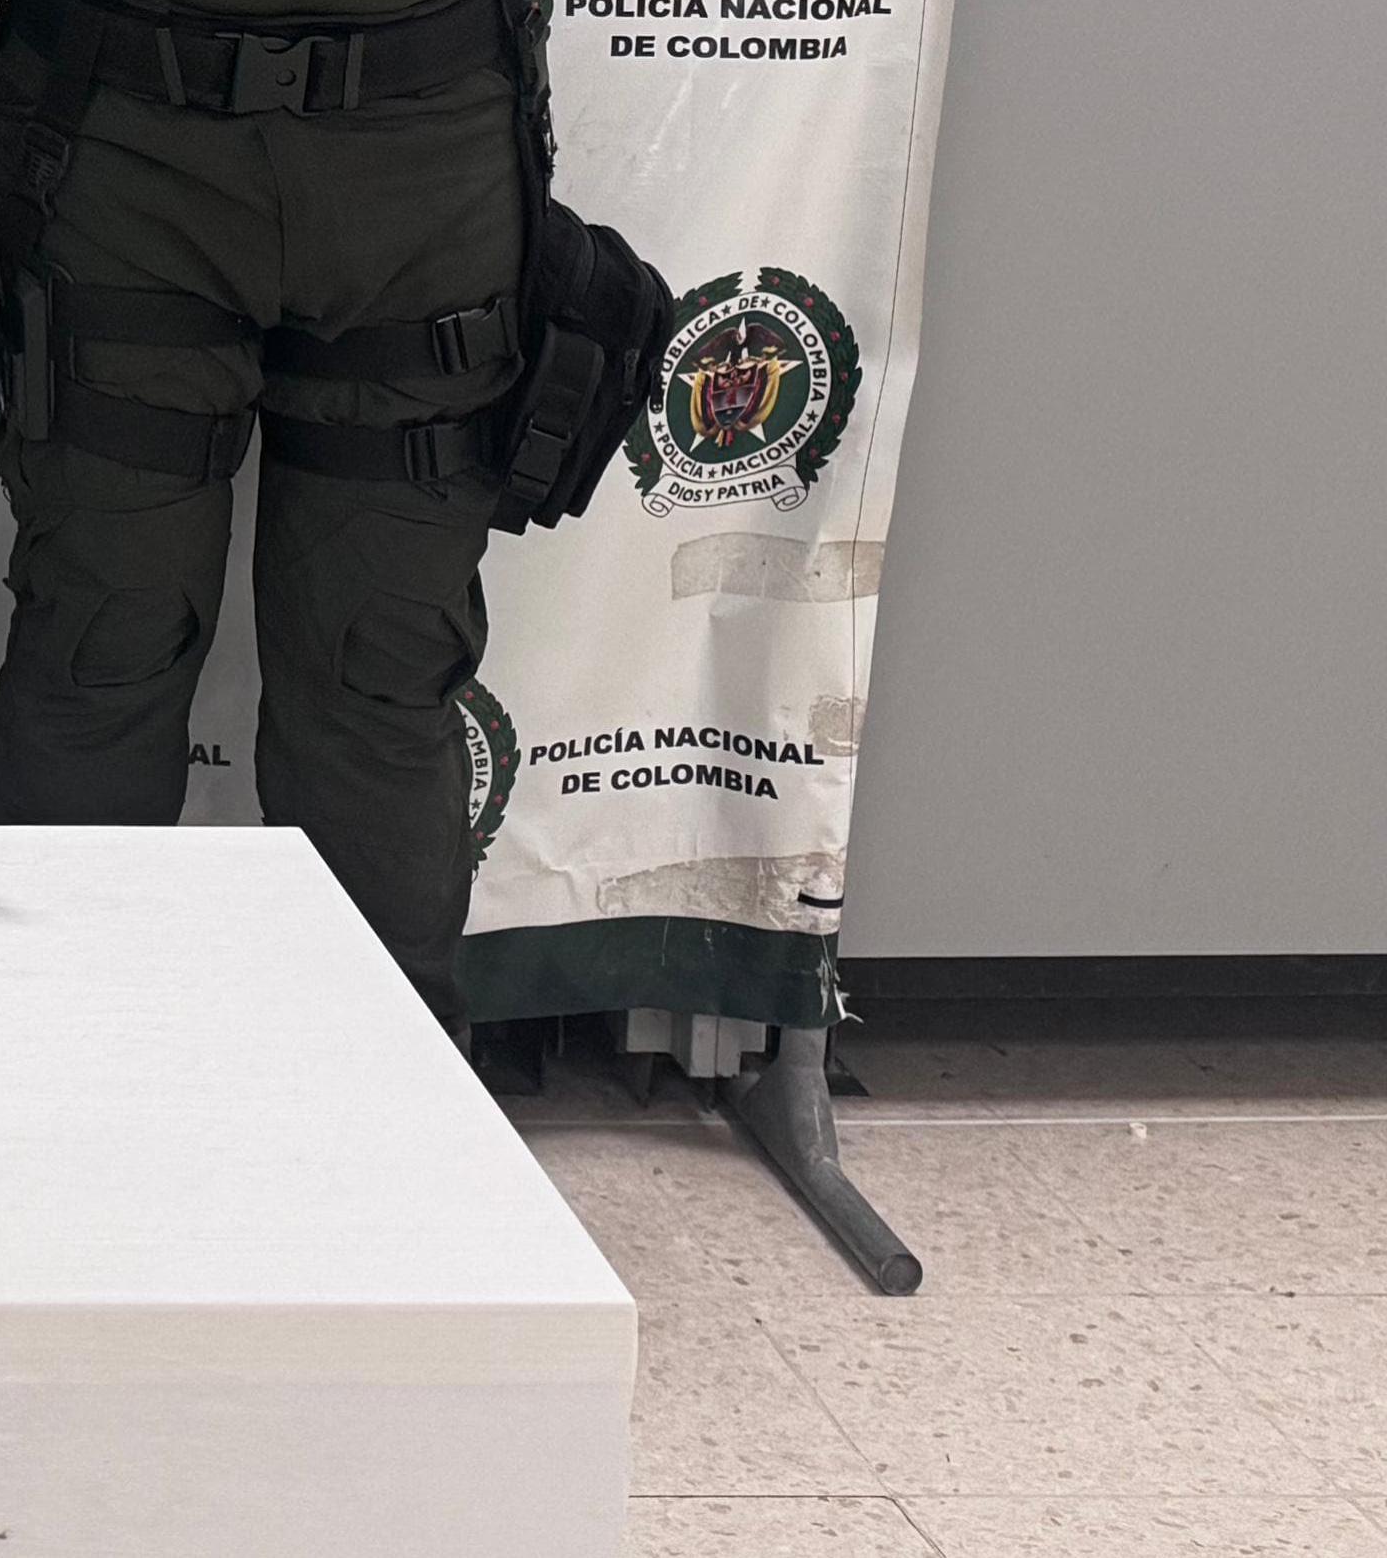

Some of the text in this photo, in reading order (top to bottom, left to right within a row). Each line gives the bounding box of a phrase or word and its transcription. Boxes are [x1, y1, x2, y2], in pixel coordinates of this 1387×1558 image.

[611, 36, 846, 59] DE COLOMBIA
[738, 296, 825, 402] DE COLOMBIA
[721, 421, 814, 478] NACIONAL
[718, 473, 785, 499] PATRIA
[530, 727, 824, 765] POLICÍA NACIONAL
[562, 764, 778, 799] DE COLOMBIA
